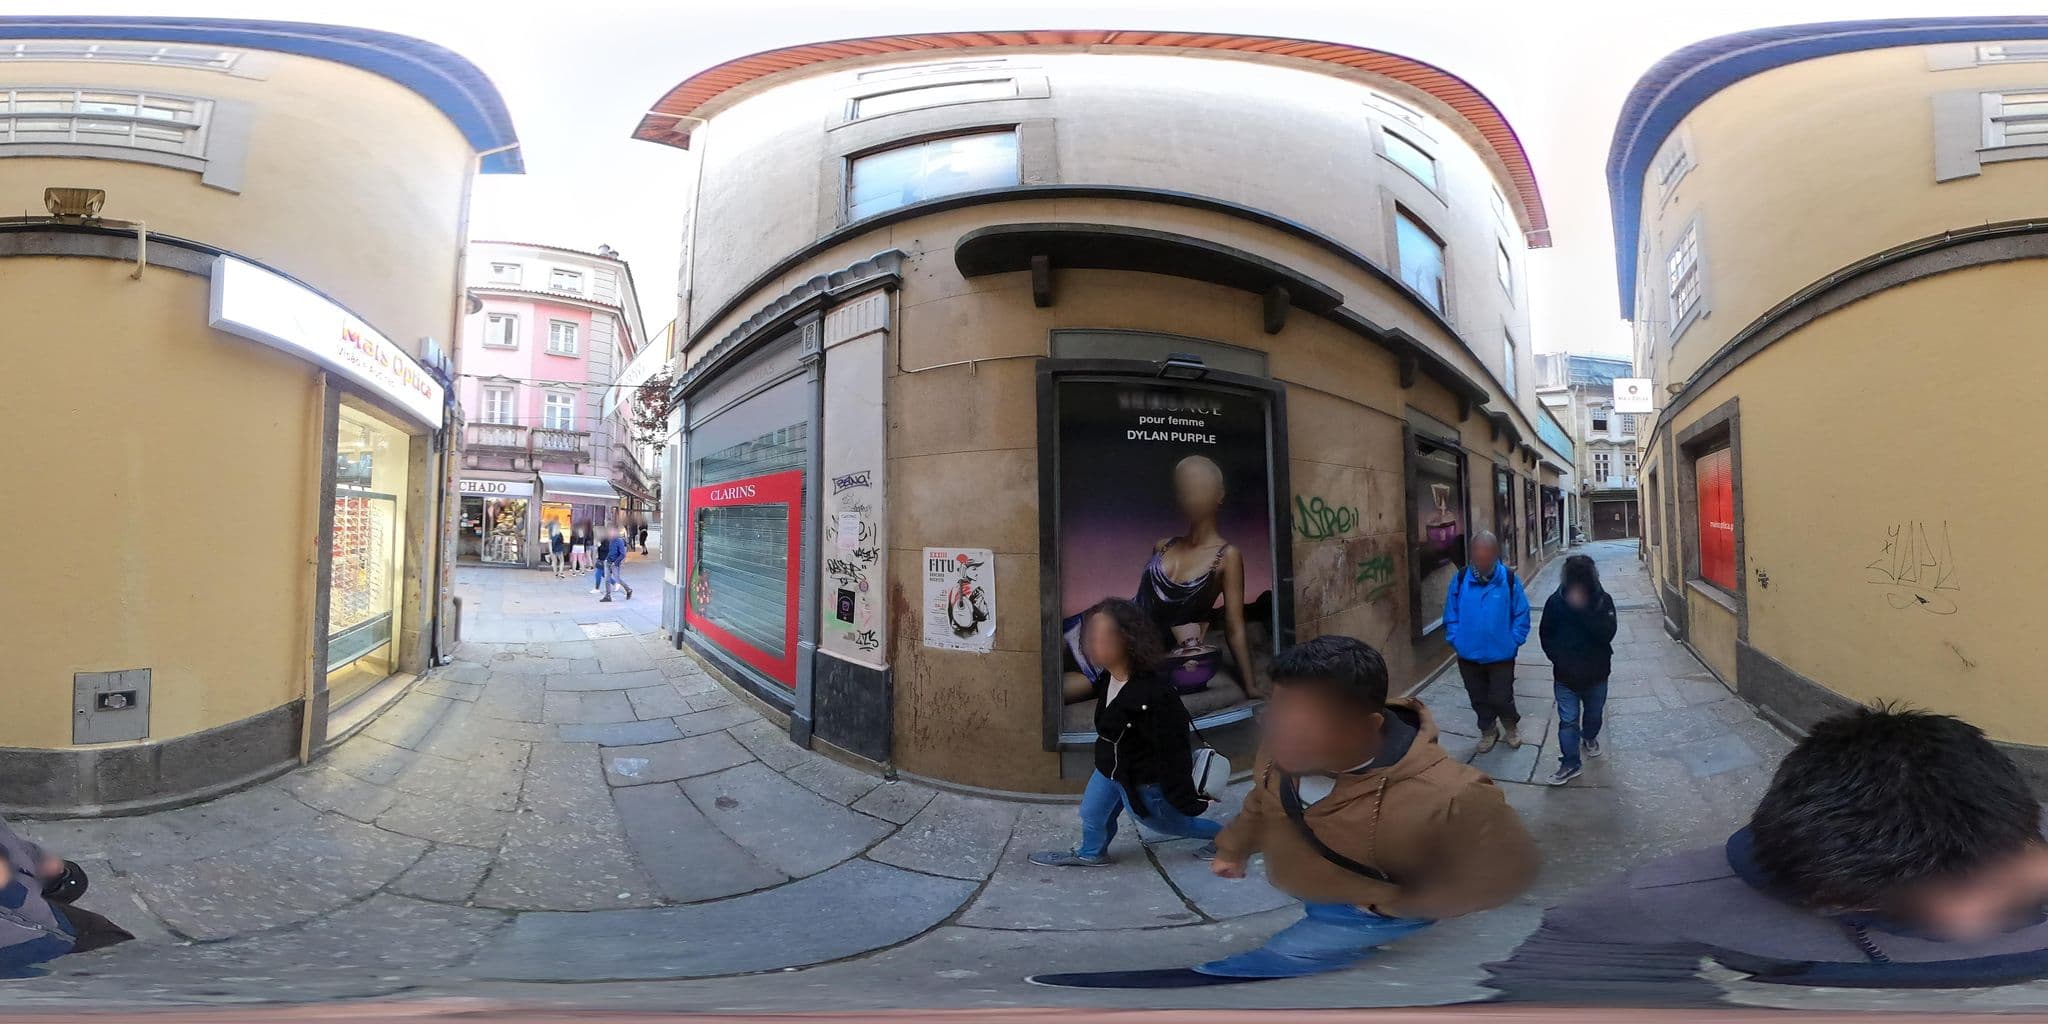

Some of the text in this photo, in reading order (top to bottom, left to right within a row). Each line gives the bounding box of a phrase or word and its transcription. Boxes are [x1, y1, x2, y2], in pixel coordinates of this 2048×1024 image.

[1139, 416, 1205, 427] pour femme
[1127, 430, 1217, 444] DYLAN PURPLE
[459, 481, 507, 493] CHADO
[710, 485, 756, 500] CLARINS
[929, 558, 955, 573] FITU
